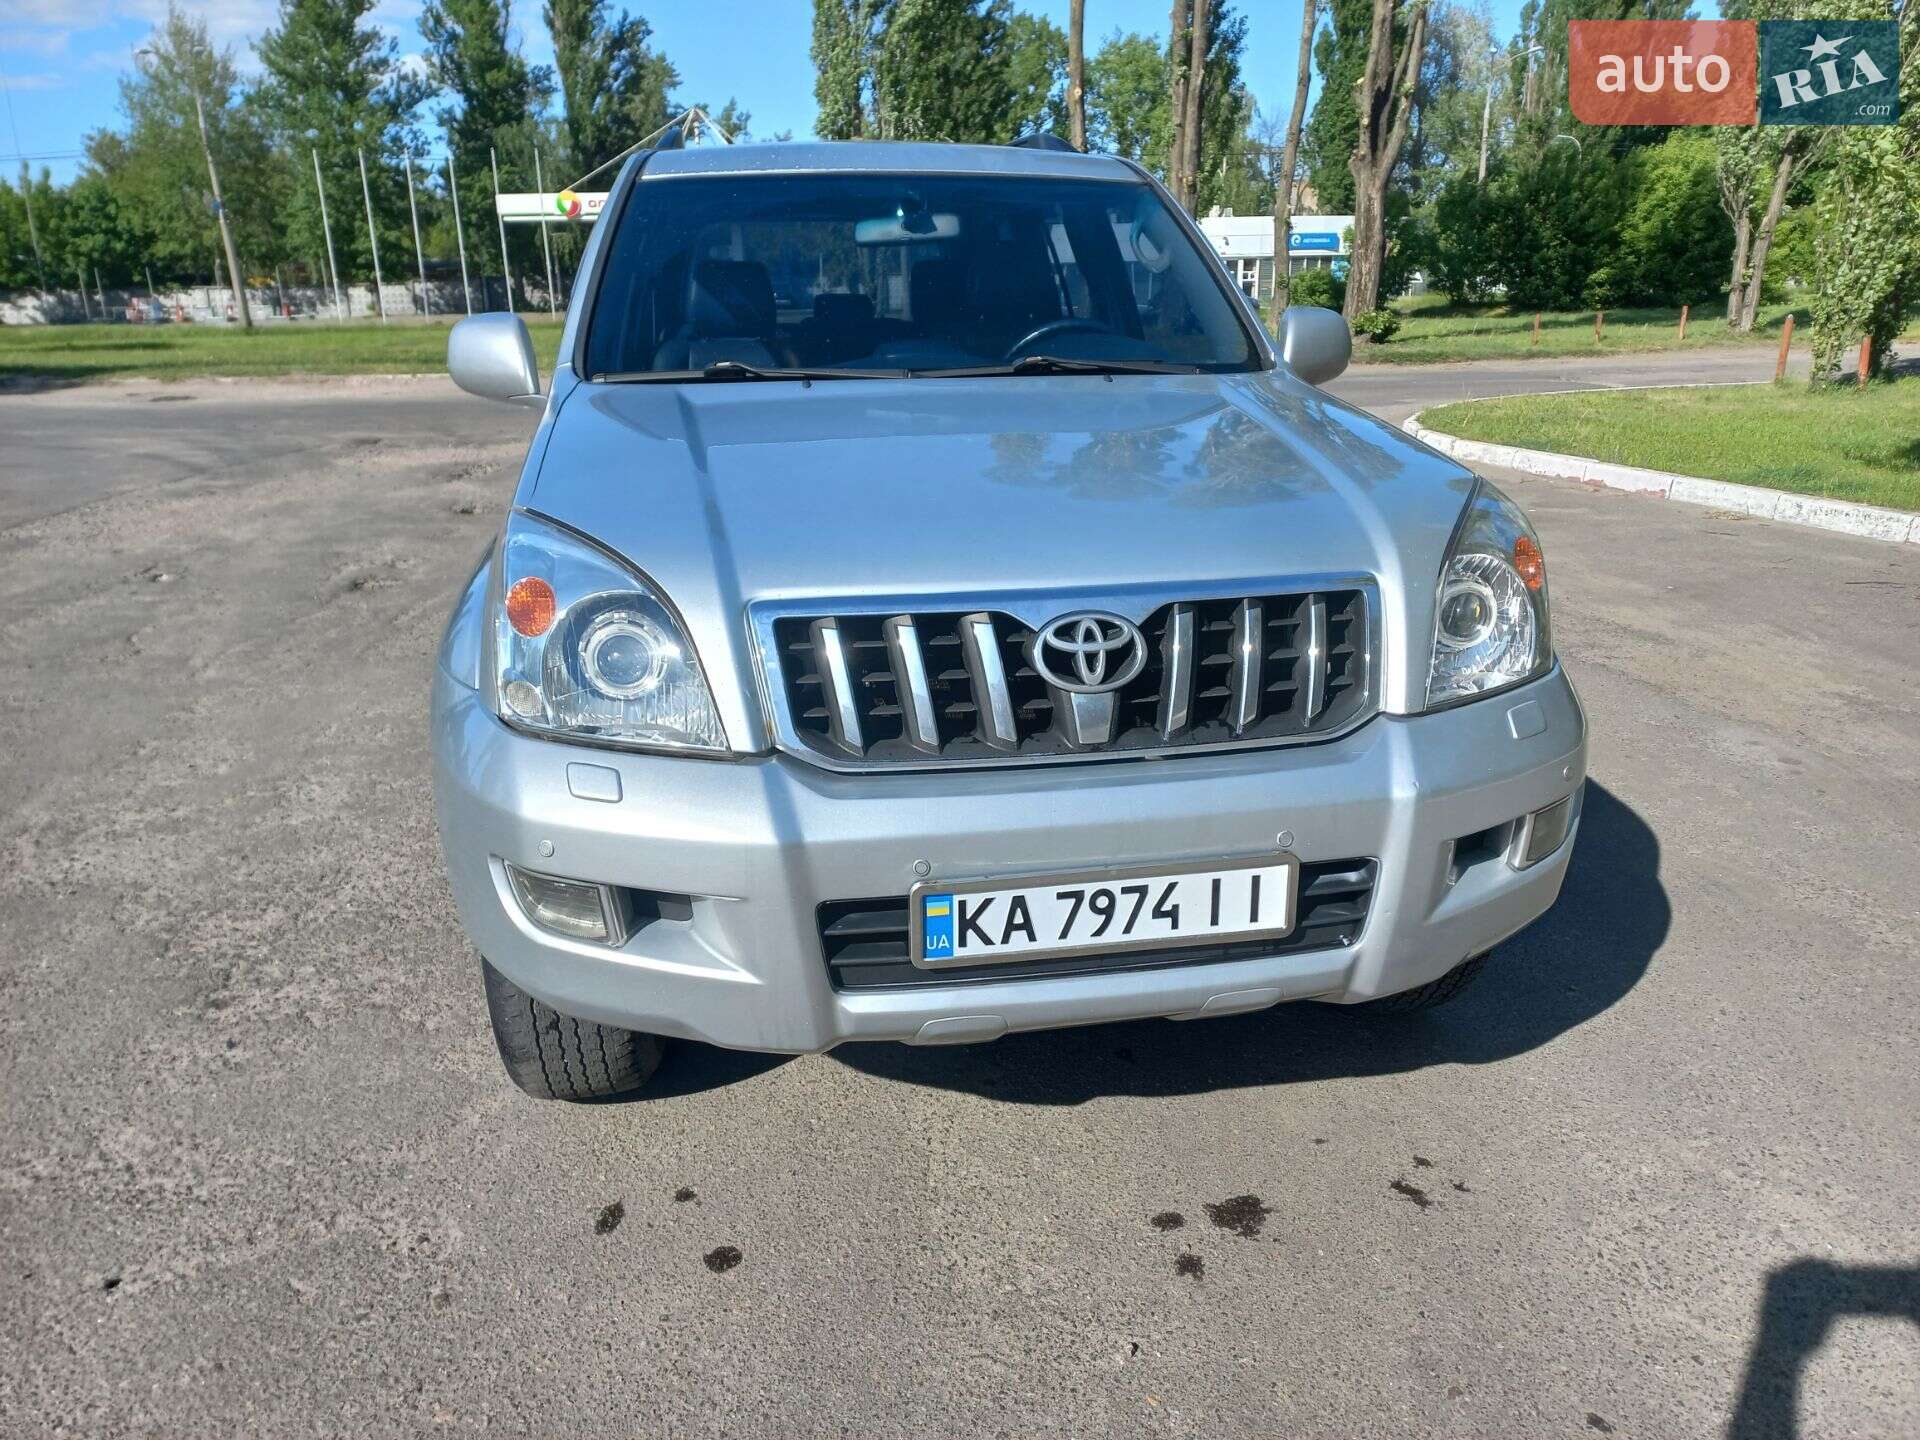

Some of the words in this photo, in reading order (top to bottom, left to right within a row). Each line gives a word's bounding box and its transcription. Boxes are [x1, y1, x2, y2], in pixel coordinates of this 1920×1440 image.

[957, 894, 1037, 948] KA
[1056, 881, 1180, 940] 7974
[926, 936, 950, 951] UA
